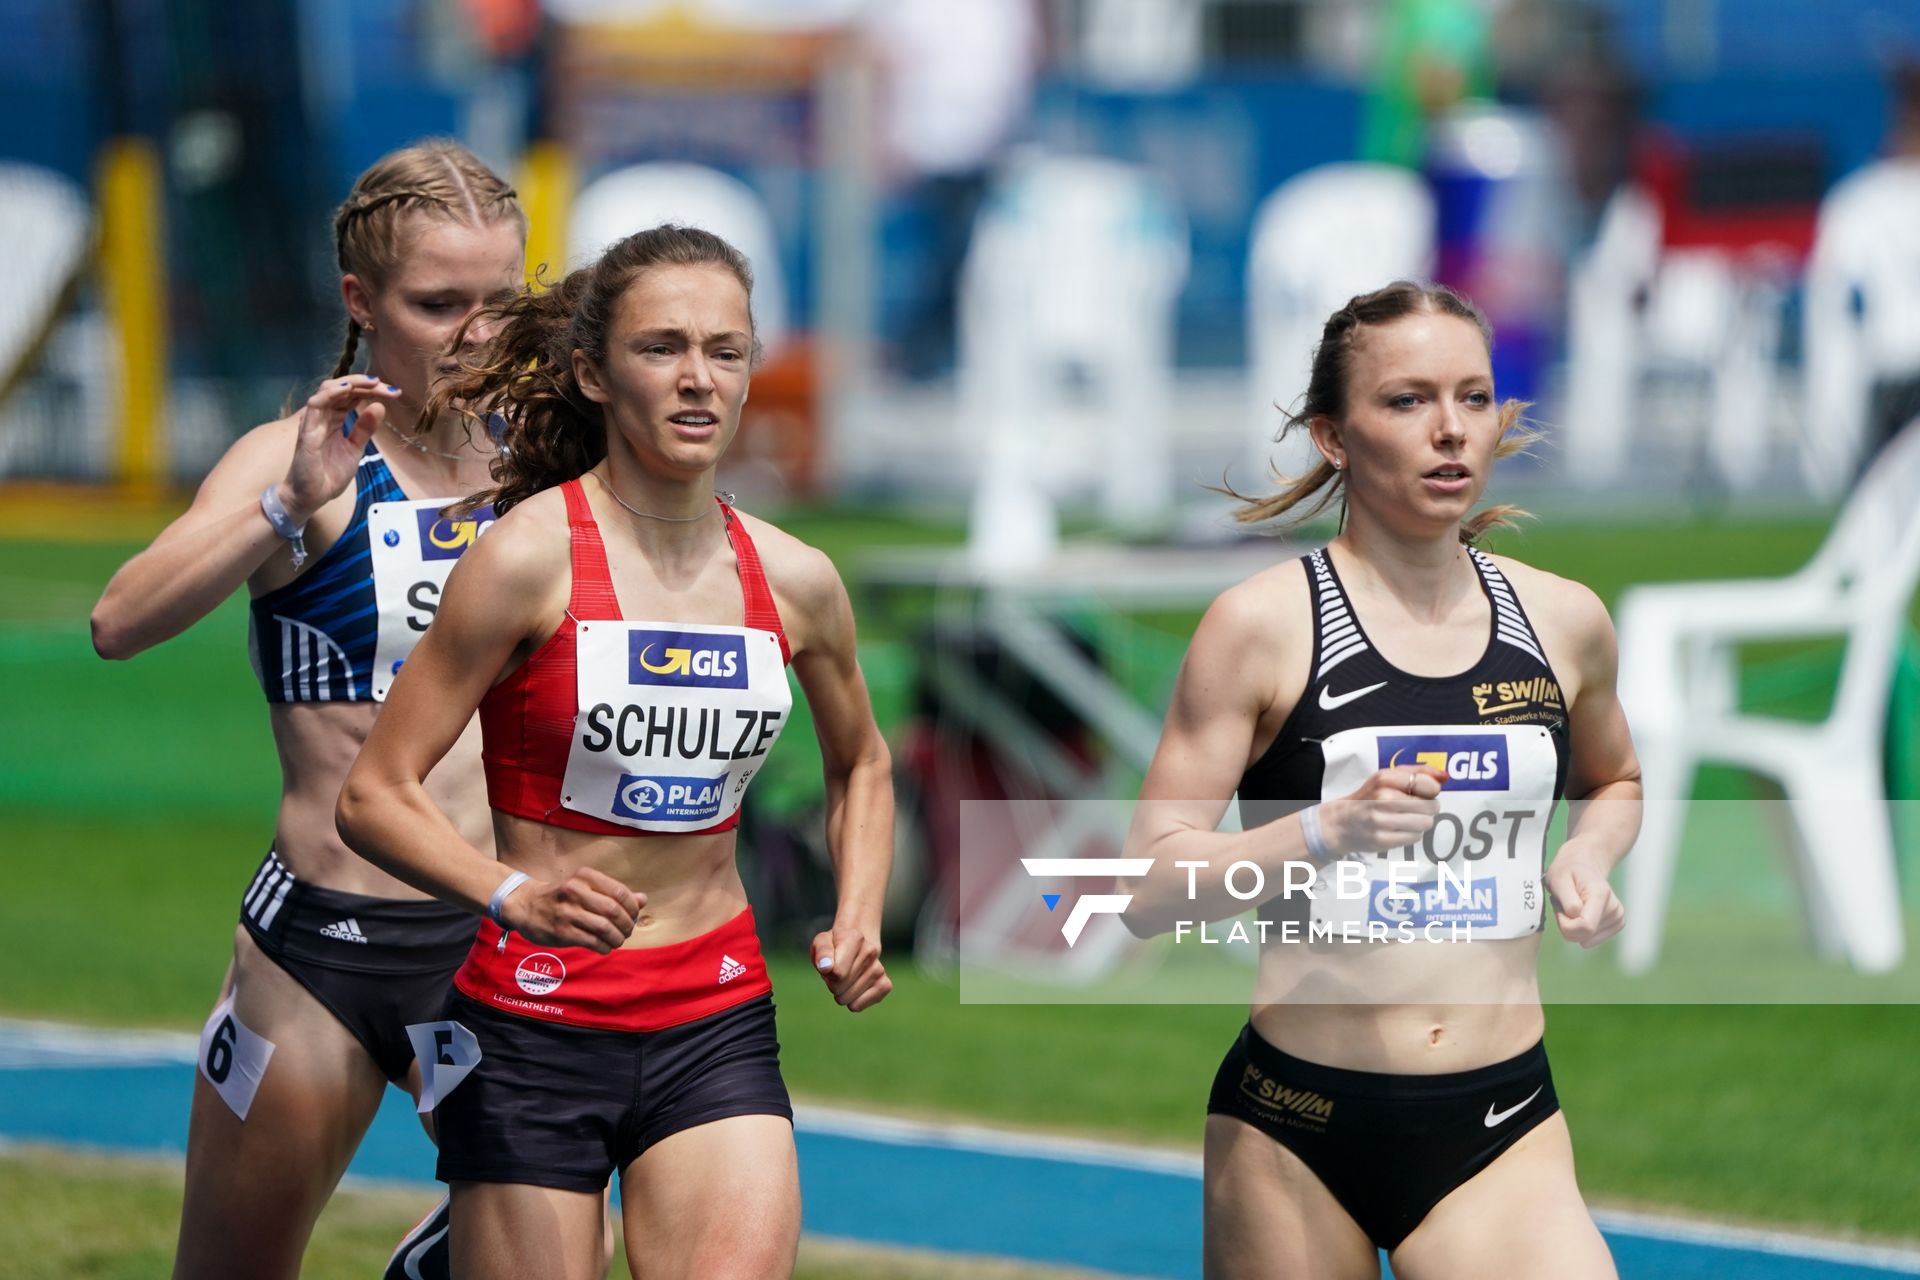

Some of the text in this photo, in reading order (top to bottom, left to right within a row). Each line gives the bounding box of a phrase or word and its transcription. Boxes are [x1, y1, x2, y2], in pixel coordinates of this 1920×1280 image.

[691, 650, 738, 678] GLS
[582, 702, 782, 760] SCHULZE
[1448, 751, 1498, 780] GLS
[668, 783, 723, 805] PLAN
[666, 806, 718, 815] INTERNATIONAL
[1377, 810, 1535, 865] OST
[1425, 888, 1492, 911] PLAN
[1523, 880, 1535, 910] 362
[1425, 913, 1492, 922] INTERNATIONAL
[320, 927, 368, 944] adidas
[518, 970, 560, 985] EINTRACHT
[719, 964, 746, 984] adidas
[493, 993, 564, 1015] LEICHTATHLETIK
[206, 1014, 236, 1084] 6
